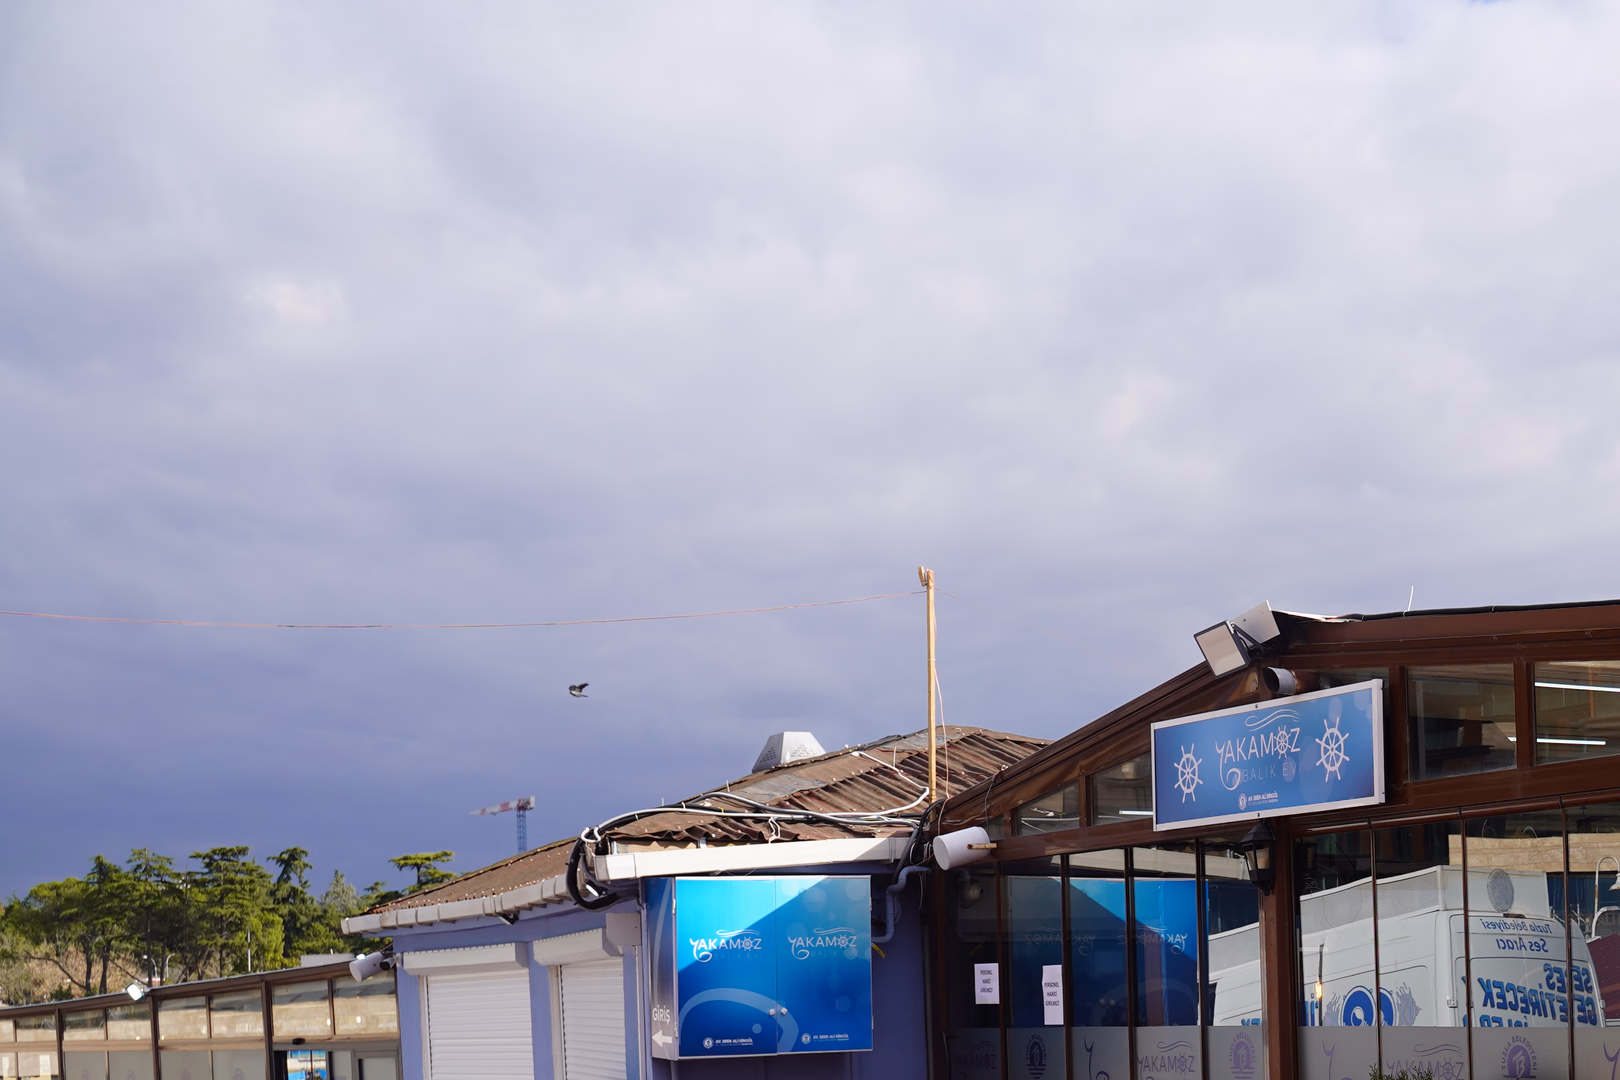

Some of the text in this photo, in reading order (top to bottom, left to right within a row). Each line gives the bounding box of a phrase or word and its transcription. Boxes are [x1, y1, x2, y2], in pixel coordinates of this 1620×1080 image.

[1215, 724, 1301, 791] YAKAMOZ
[1242, 764, 1276, 783] BALIK
[689, 936, 763, 963] YAKAMOZ
[788, 934, 858, 960] YAKAMOZ
[653, 1004, 671, 1025] GİRİŞ
